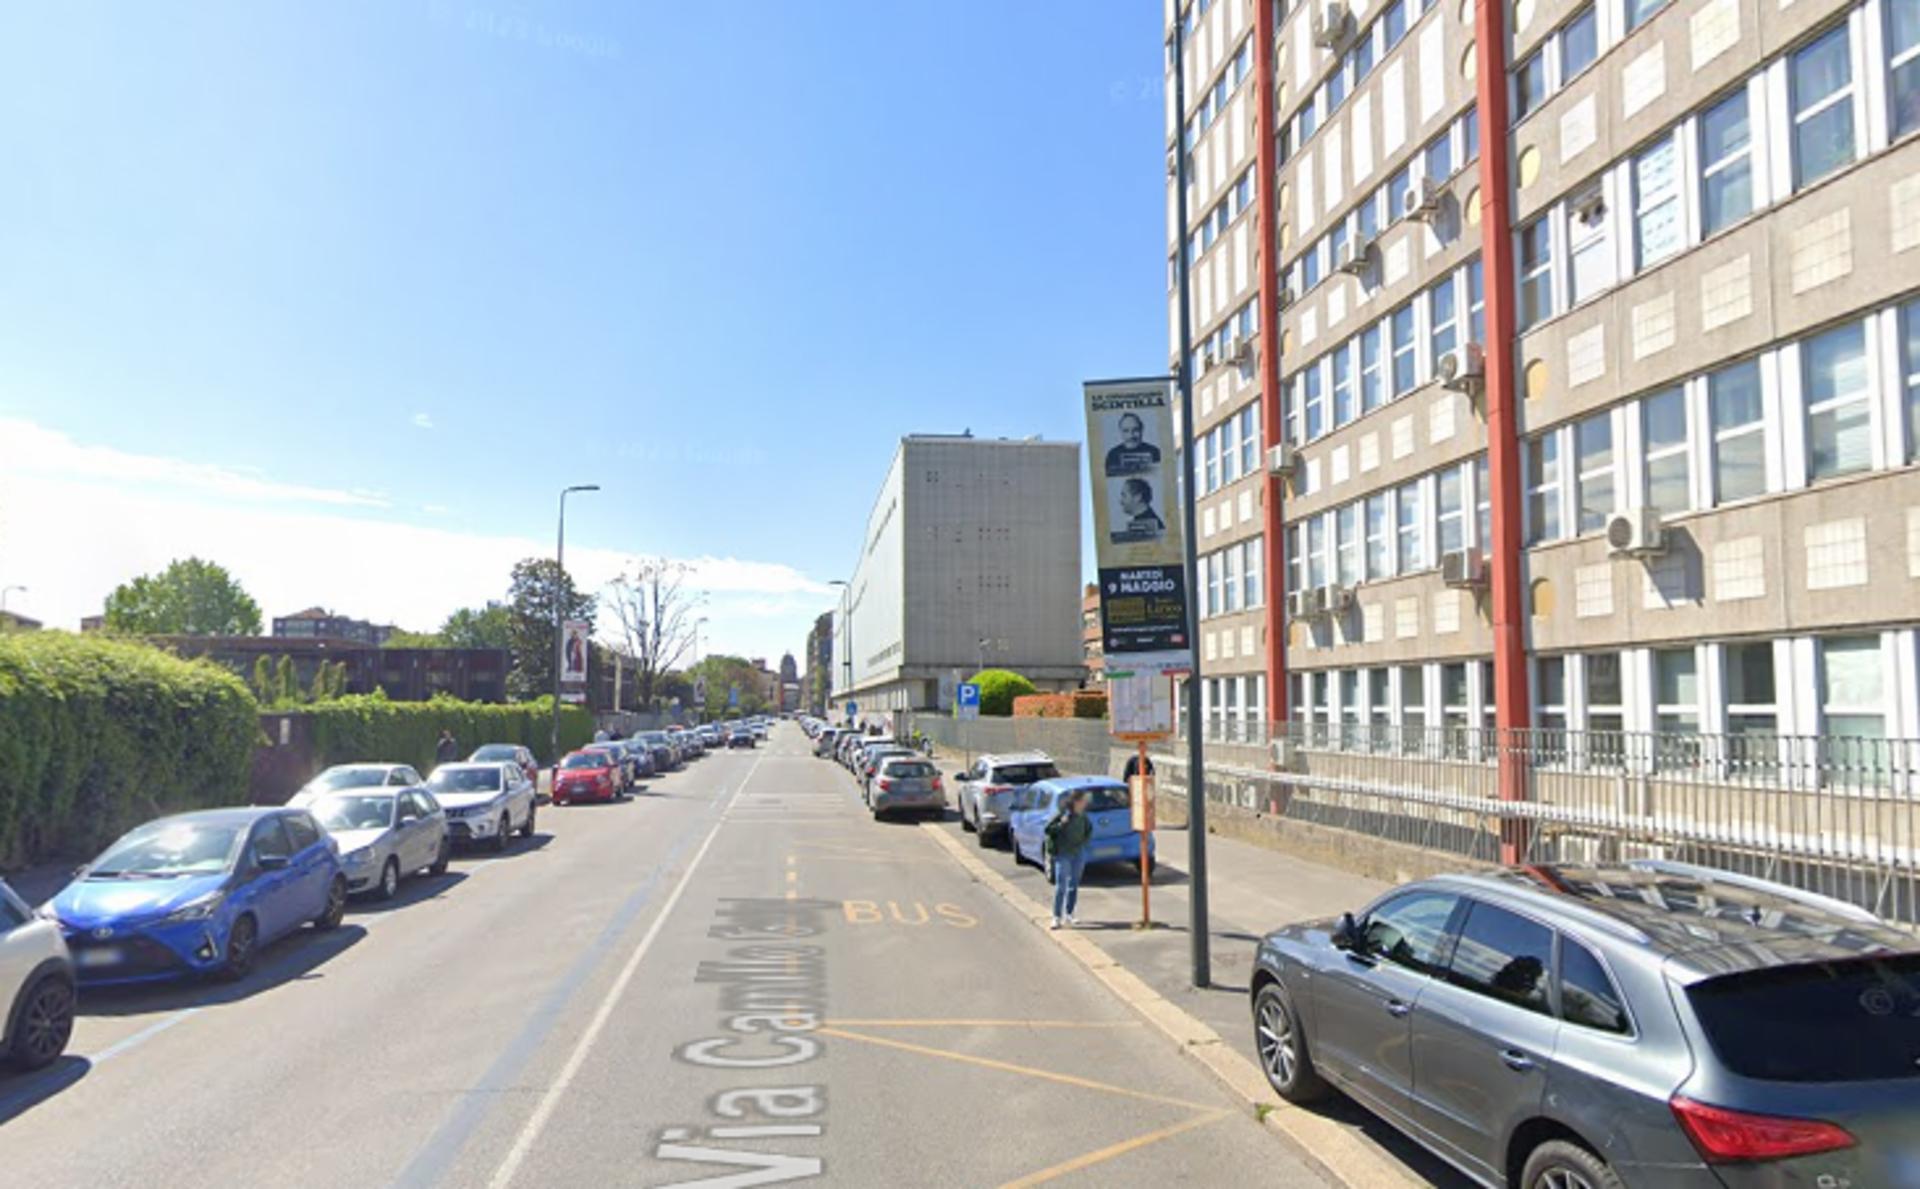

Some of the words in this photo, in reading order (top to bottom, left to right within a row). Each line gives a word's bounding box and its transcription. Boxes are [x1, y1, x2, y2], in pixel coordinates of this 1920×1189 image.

[1092, 397, 1165, 411] SCINTILLA
[1107, 582, 1118, 594] 9
[1120, 579, 1175, 593] MAGGIO
[961, 685, 976, 703] P
[842, 899, 979, 928] BUS
